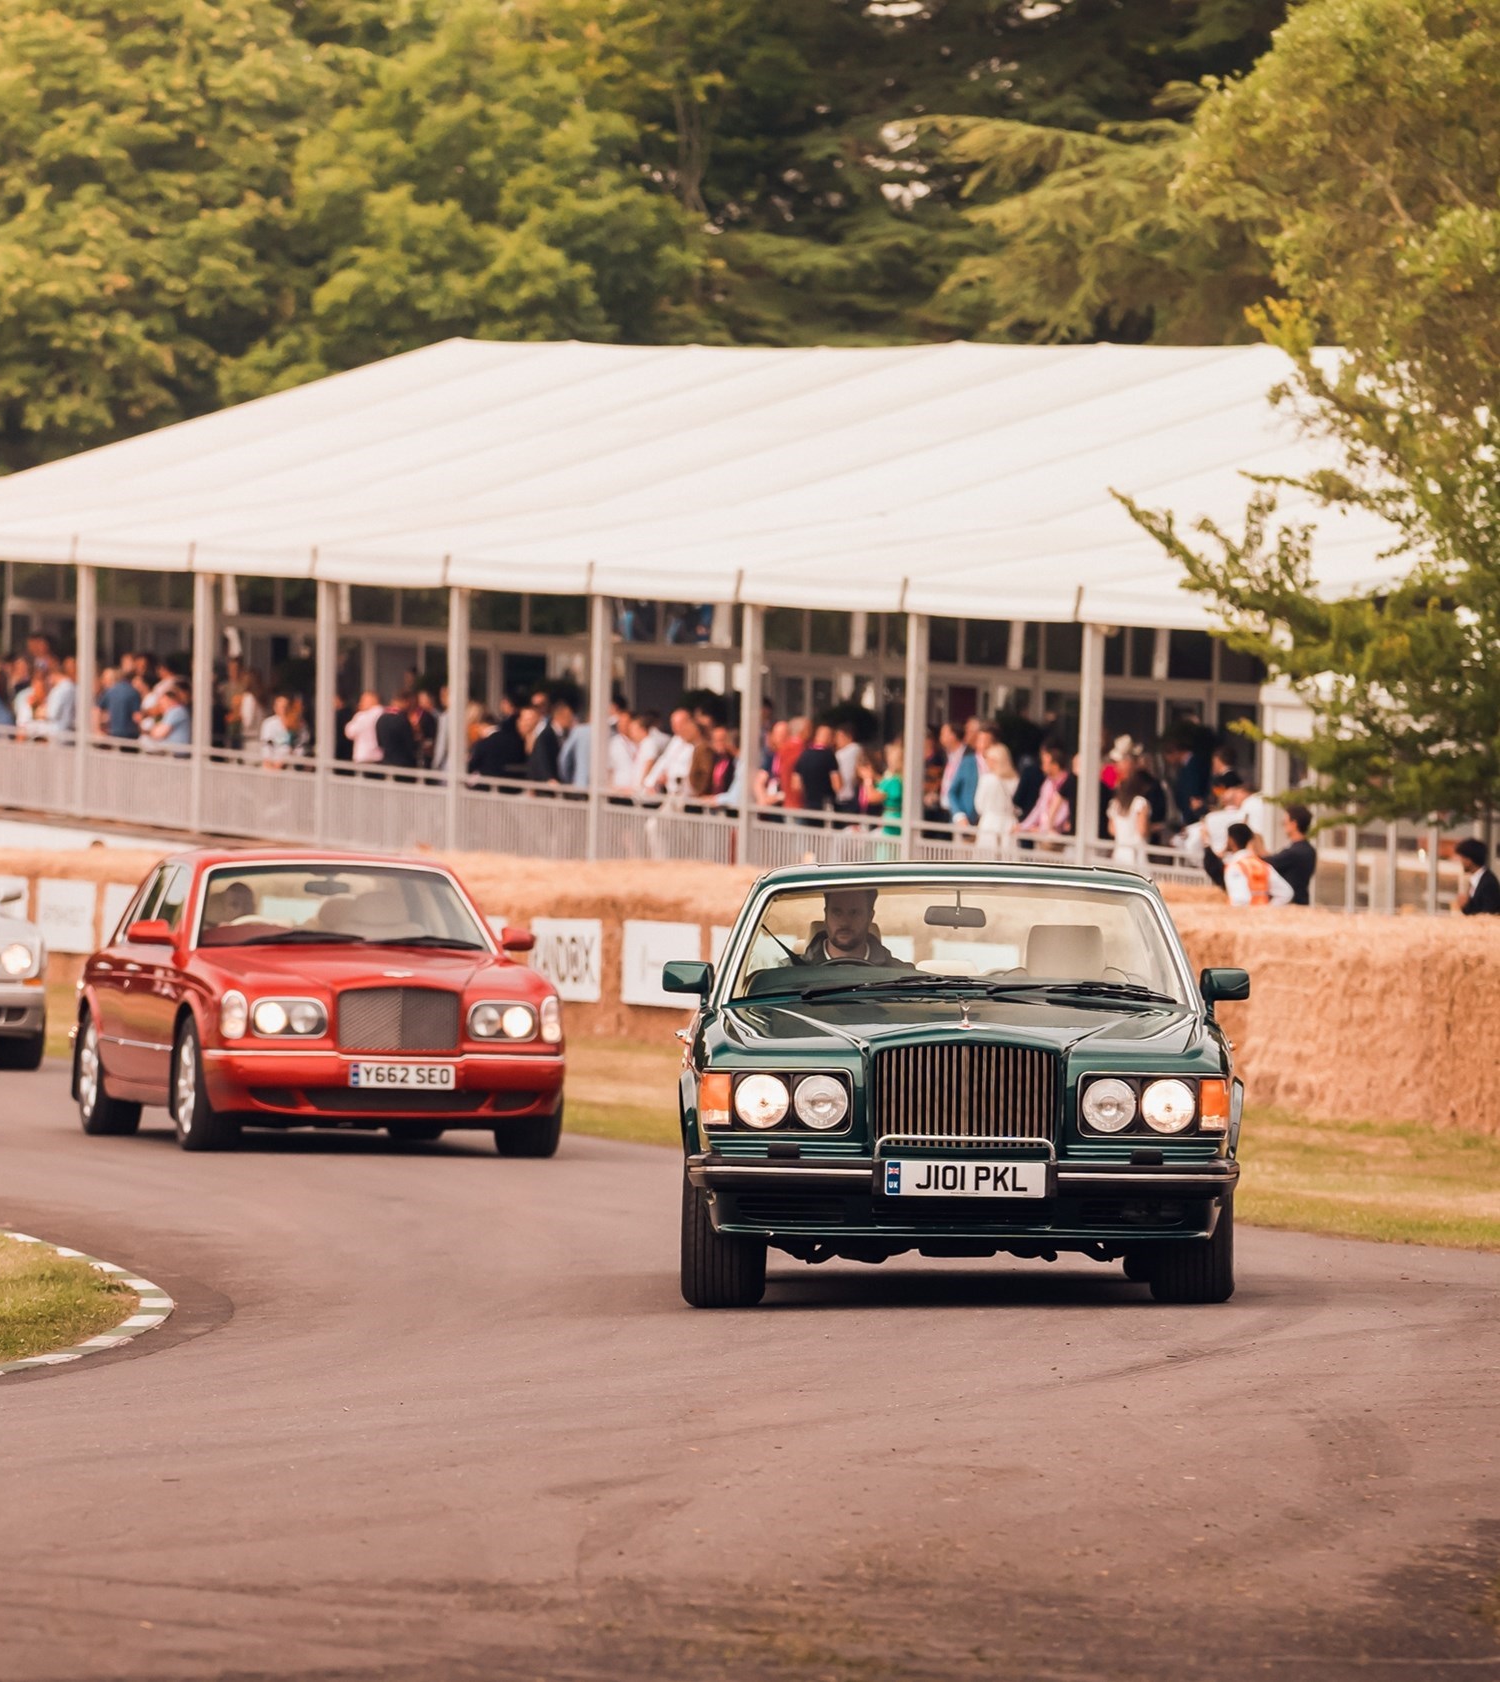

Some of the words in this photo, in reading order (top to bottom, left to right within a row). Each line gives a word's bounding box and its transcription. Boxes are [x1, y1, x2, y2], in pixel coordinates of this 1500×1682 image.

[363, 1066, 409, 1083] Y662
[416, 1068, 450, 1085] SEO
[888, 1181, 899, 1189] UK
[915, 1164, 966, 1190] J101
[974, 1166, 1028, 1192] PKL
